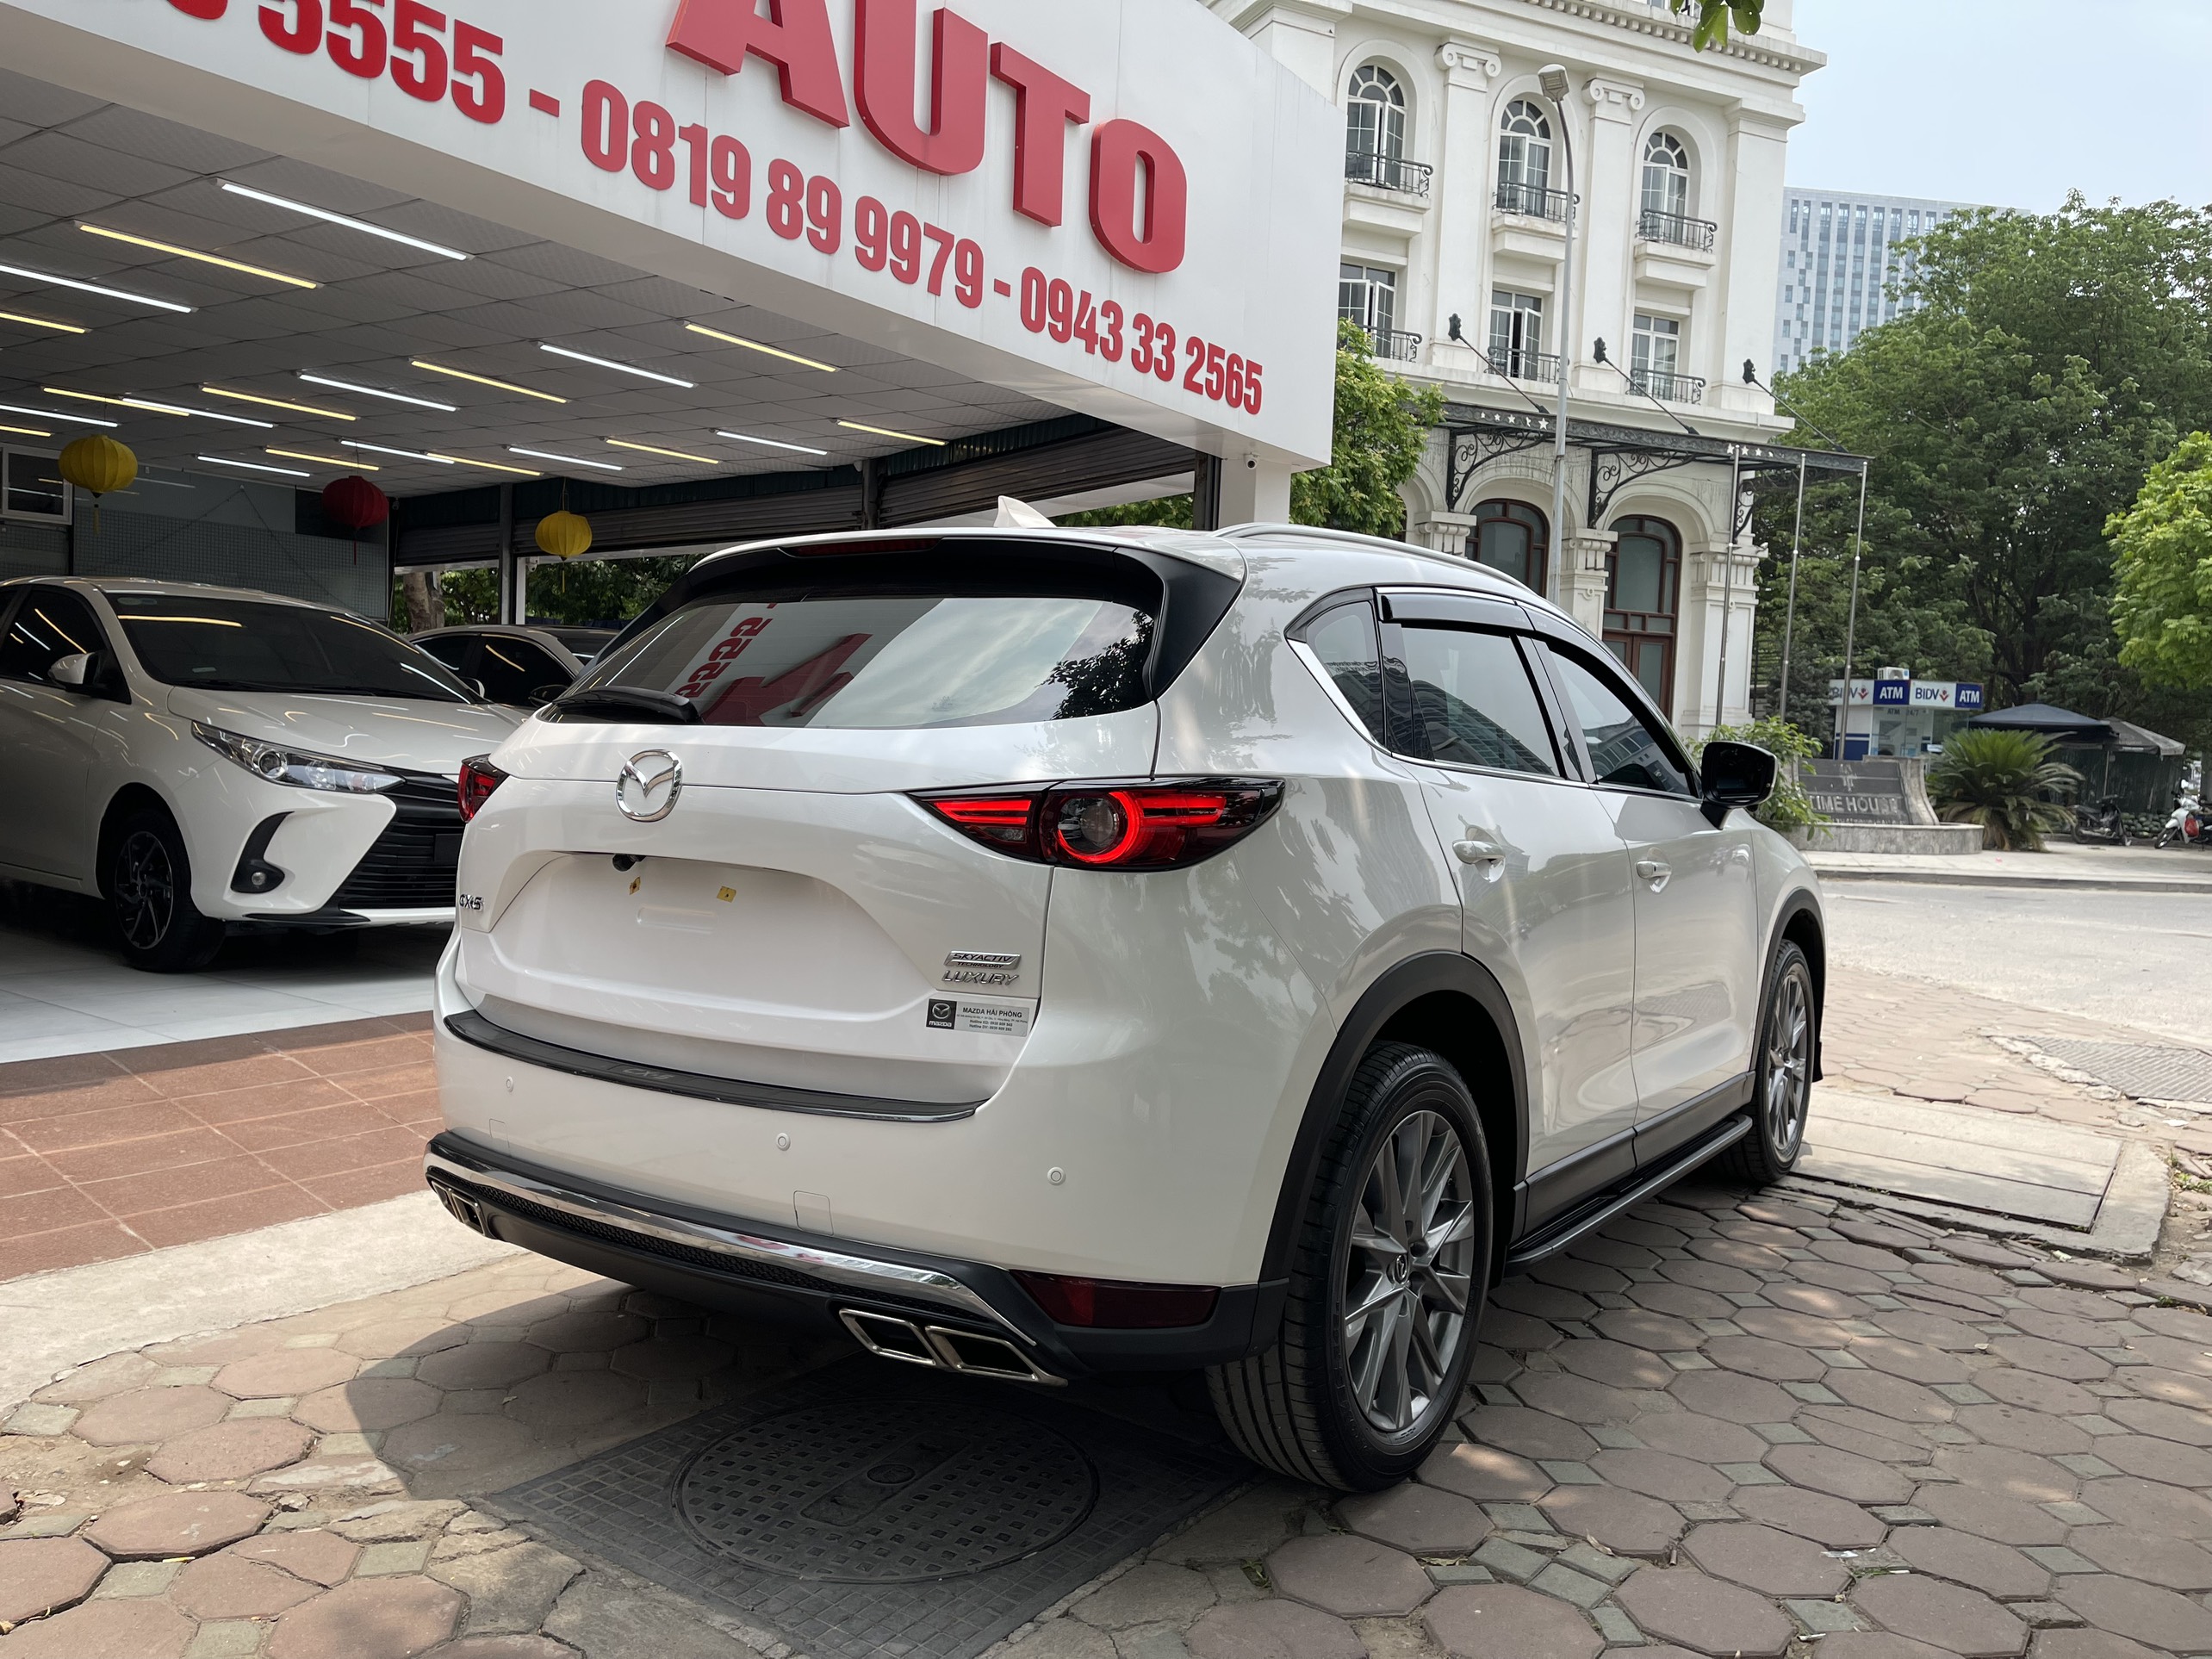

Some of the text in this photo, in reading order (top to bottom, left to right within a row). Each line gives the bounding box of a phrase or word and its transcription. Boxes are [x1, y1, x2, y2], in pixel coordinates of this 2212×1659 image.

[666, 0, 1188, 274] AUTO
[581, 79, 751, 220] 0819
[766, 158, 842, 255] 89
[854, 196, 984, 309] 9979
[1020, 266, 1123, 362] 0943
[1130, 313, 1176, 382] 33
[1183, 336, 1264, 416] 2565
[1831, 686, 1904, 699] BIV ATM
[1915, 687, 1980, 704] BIDV ATM
[1809, 795, 1844, 813] TIME
[952, 953, 1013, 962] SKYACTIV
[941, 970, 1020, 985] LUXURY
